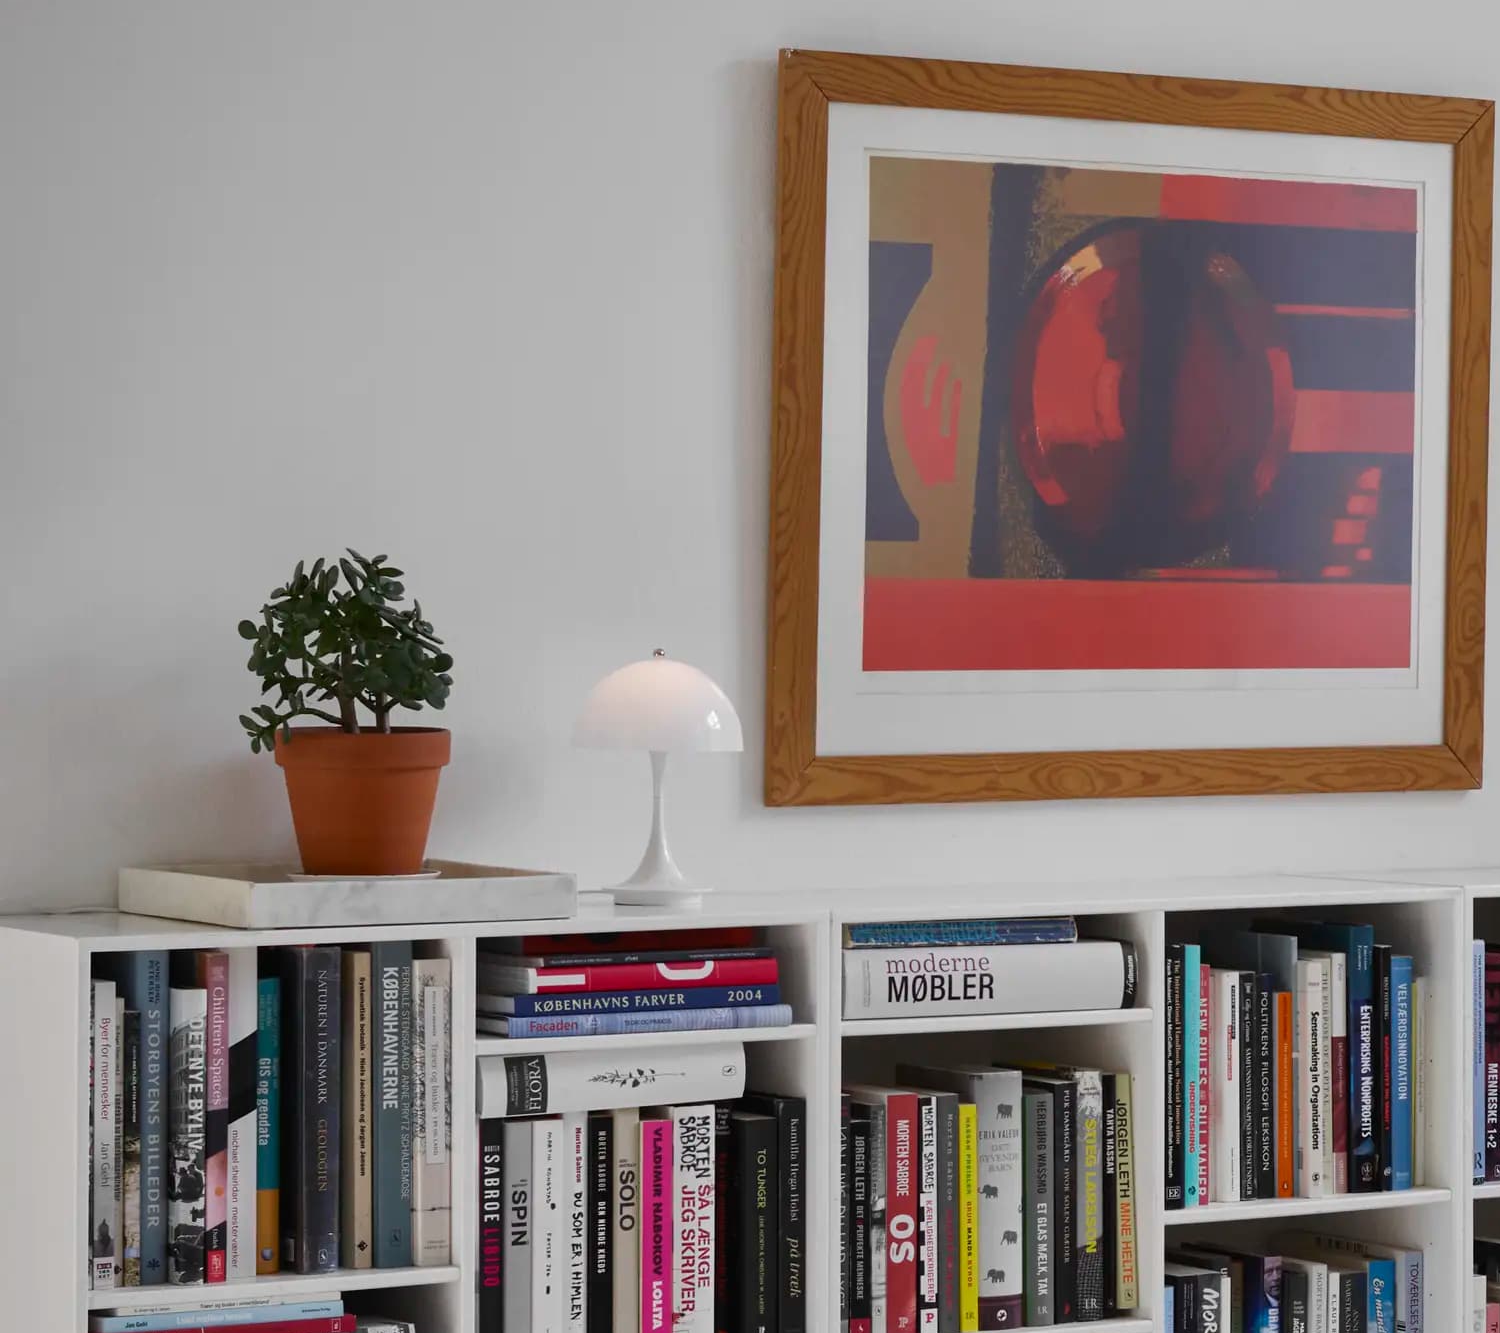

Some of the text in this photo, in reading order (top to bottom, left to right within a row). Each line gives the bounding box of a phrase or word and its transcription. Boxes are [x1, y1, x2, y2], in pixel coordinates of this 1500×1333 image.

[728, 990, 762, 1002] 2004
[887, 954, 990, 973] moderne
[888, 974, 994, 1003] MØBLER
[318, 970, 328, 1027] NATUREN
[534, 994, 685, 1012] KØBENHAVNS FARVER
[1260, 992, 1269, 1056] POLITIKENS
[100, 1018, 110, 1120] Byer for mennesker
[211, 987, 225, 1105] Children's Spaces
[382, 967, 399, 1109] KØBENHAVNERNE
[1398, 983, 1407, 1099] VELFÆRDSINNOVATION
[188, 1018, 203, 1150] DET NYE BYLIV
[318, 1042, 328, 1103] DANMARK
[528, 1058, 541, 1110] FLORA
[1261, 1062, 1269, 1111] FILOSOFI
[1310, 1012, 1320, 1150] Sensemaking in Organizations
[1487, 1063, 1498, 1148] MENNESKE 1+2
[147, 1009, 160, 1227] STORBYENS BILLEDER
[680, 1117, 695, 1171] SABROE
[695, 1116, 710, 1178] MORTEN
[924, 1107, 934, 1189] MORTEN SABROE
[318, 1119, 327, 1191] GEOLOGIEN
[758, 1149, 766, 1208] TO TUNGER
[897, 1120, 909, 1196] MORTEN SABROE
[1085, 1119, 1097, 1253] STIEG LARSSON
[484, 1155, 500, 1287] SABROE LIBIDO
[511, 1190, 527, 1246] SPIN
[619, 1170, 634, 1231] SOLO
[1116, 1099, 1133, 1283] JØRGEN LETH MINE HELTE
[653, 1128, 662, 1329] VLADIMIR NABOKOV LOLITA
[681, 1185, 695, 1312] JEG SKRIVER
[698, 1185, 713, 1287] SÅ LÆNGE
[890, 1214, 914, 1264] OS
[786, 1238, 800, 1297] på træk
[1410, 1263, 1419, 1325] TOVÆRELSES
